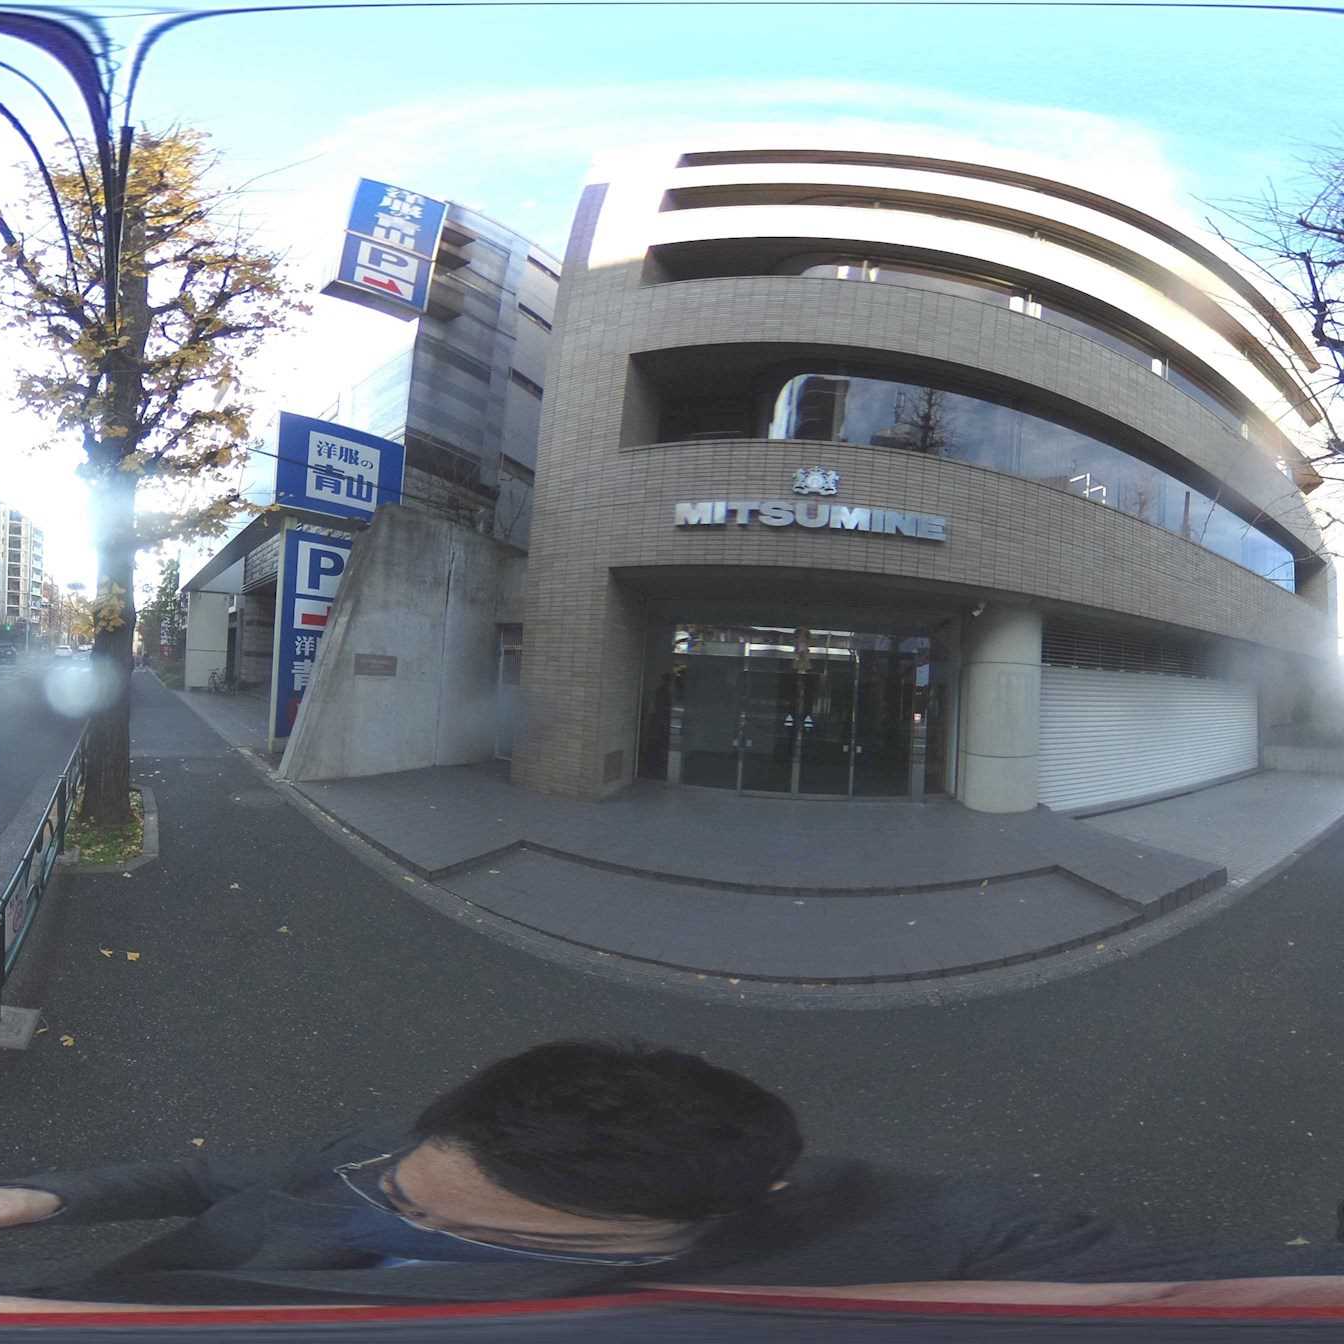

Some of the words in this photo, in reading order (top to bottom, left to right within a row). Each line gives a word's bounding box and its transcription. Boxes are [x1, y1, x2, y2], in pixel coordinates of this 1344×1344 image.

[368, 247, 409, 268] P
[316, 440, 374, 470] 洋服の
[313, 464, 373, 503] 青山
[675, 501, 946, 541] MITSUMINE
[308, 548, 345, 590] P
